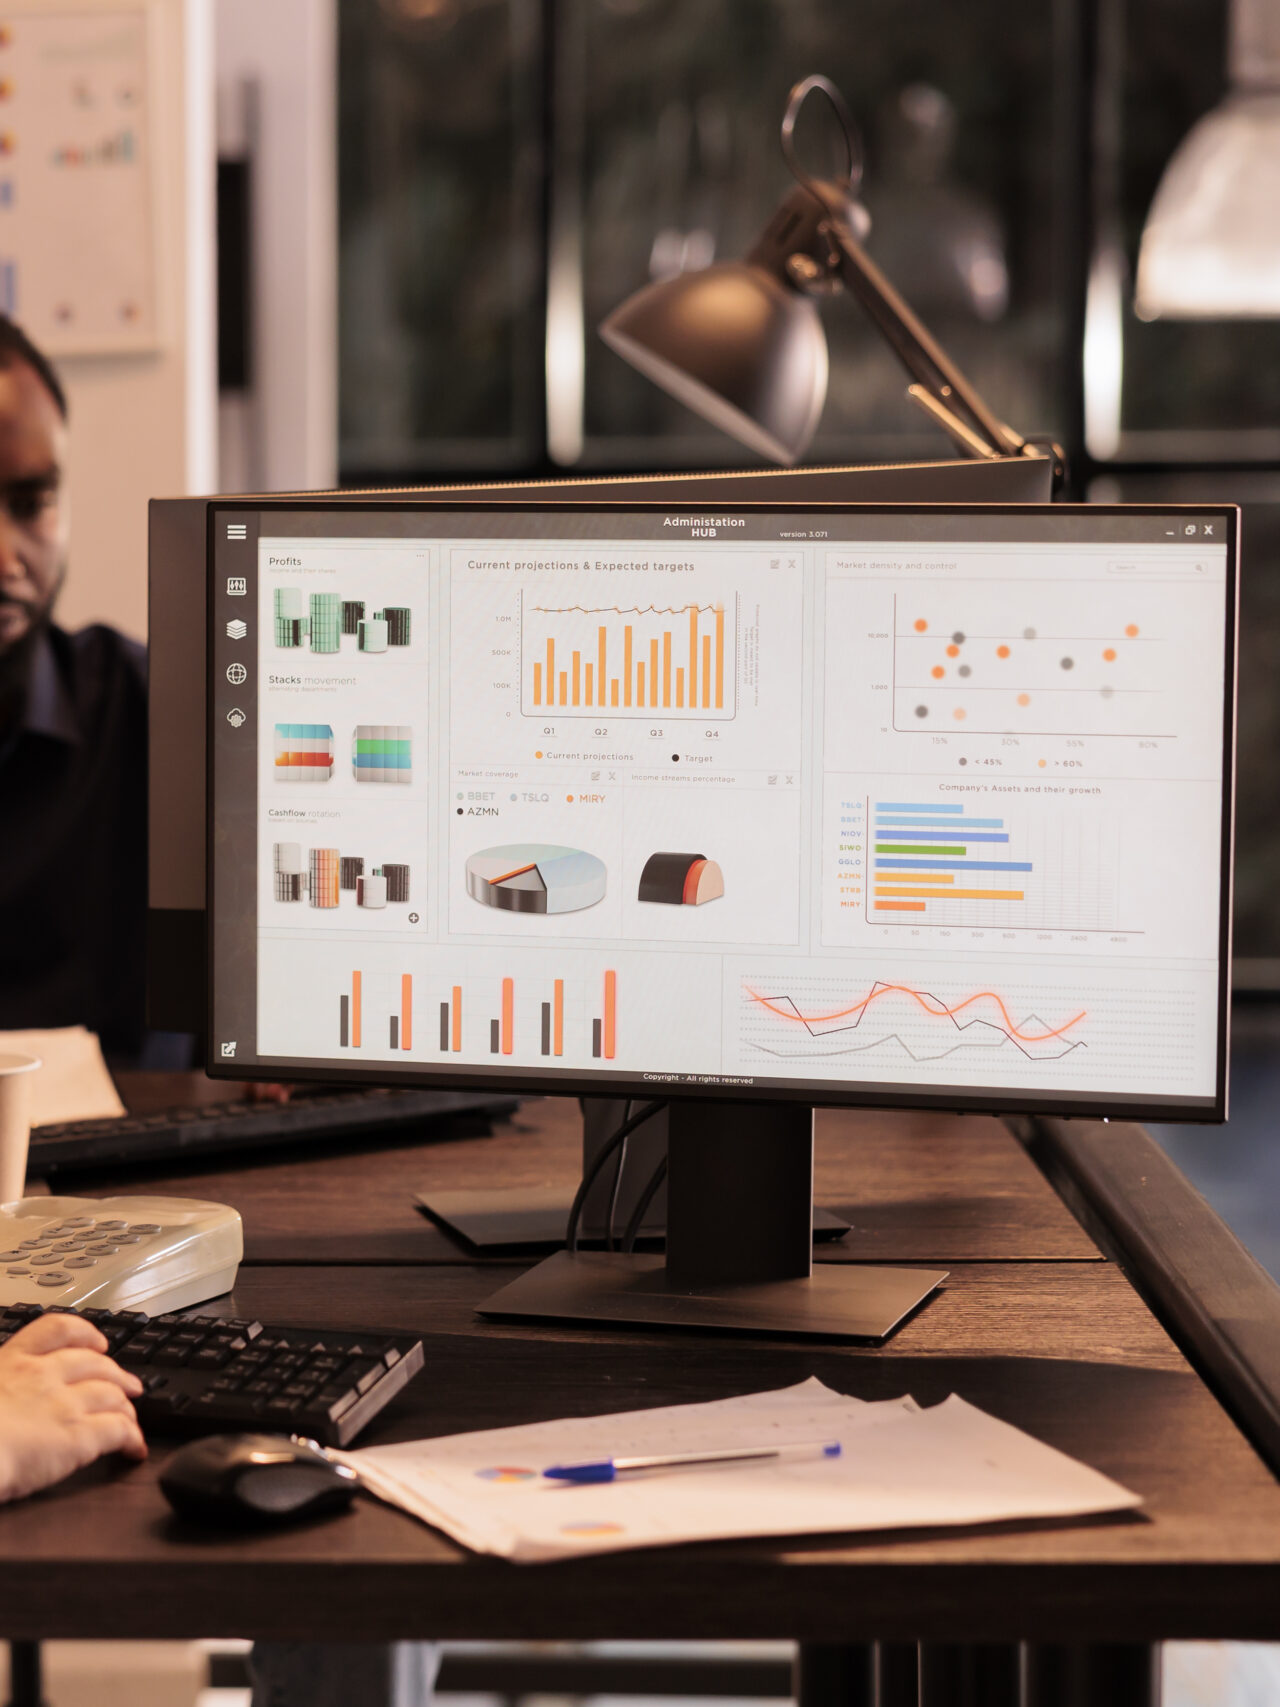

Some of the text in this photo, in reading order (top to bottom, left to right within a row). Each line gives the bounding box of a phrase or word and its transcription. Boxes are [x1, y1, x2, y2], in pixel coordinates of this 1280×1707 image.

[663, 517, 746, 527] Administation
[691, 528, 717, 537] HUB
[269, 557, 302, 566] Profits
[836, 561, 957, 571] Market density and control
[468, 560, 695, 573] Current projections & Expected targets
[268, 675, 357, 686] Stacks movement
[543, 727, 556, 735] Q1
[594, 728, 608, 736] Q2
[649, 729, 663, 737] Q3
[705, 730, 719, 738] Q4
[931, 737, 948, 745] 15%
[546, 752, 634, 762] Current projections
[684, 754, 713, 763] Target
[983, 758, 1003, 766] 45%
[1062, 759, 1083, 767] 60%
[486, 771, 519, 779] coverage
[693, 775, 736, 784] percentage
[938, 783, 1101, 796] Company's Assets and their growth
[468, 792, 606, 803] BBET TSLQ MIRY
[268, 808, 341, 818] Cashflow rotation
[468, 807, 499, 816] AZMN
[840, 830, 862, 838] NIOV
[642, 1072, 680, 1083] Copyright
[687, 1074, 697, 1082] All
[699, 1075, 721, 1084] rights
[723, 1076, 754, 1085] reserved
